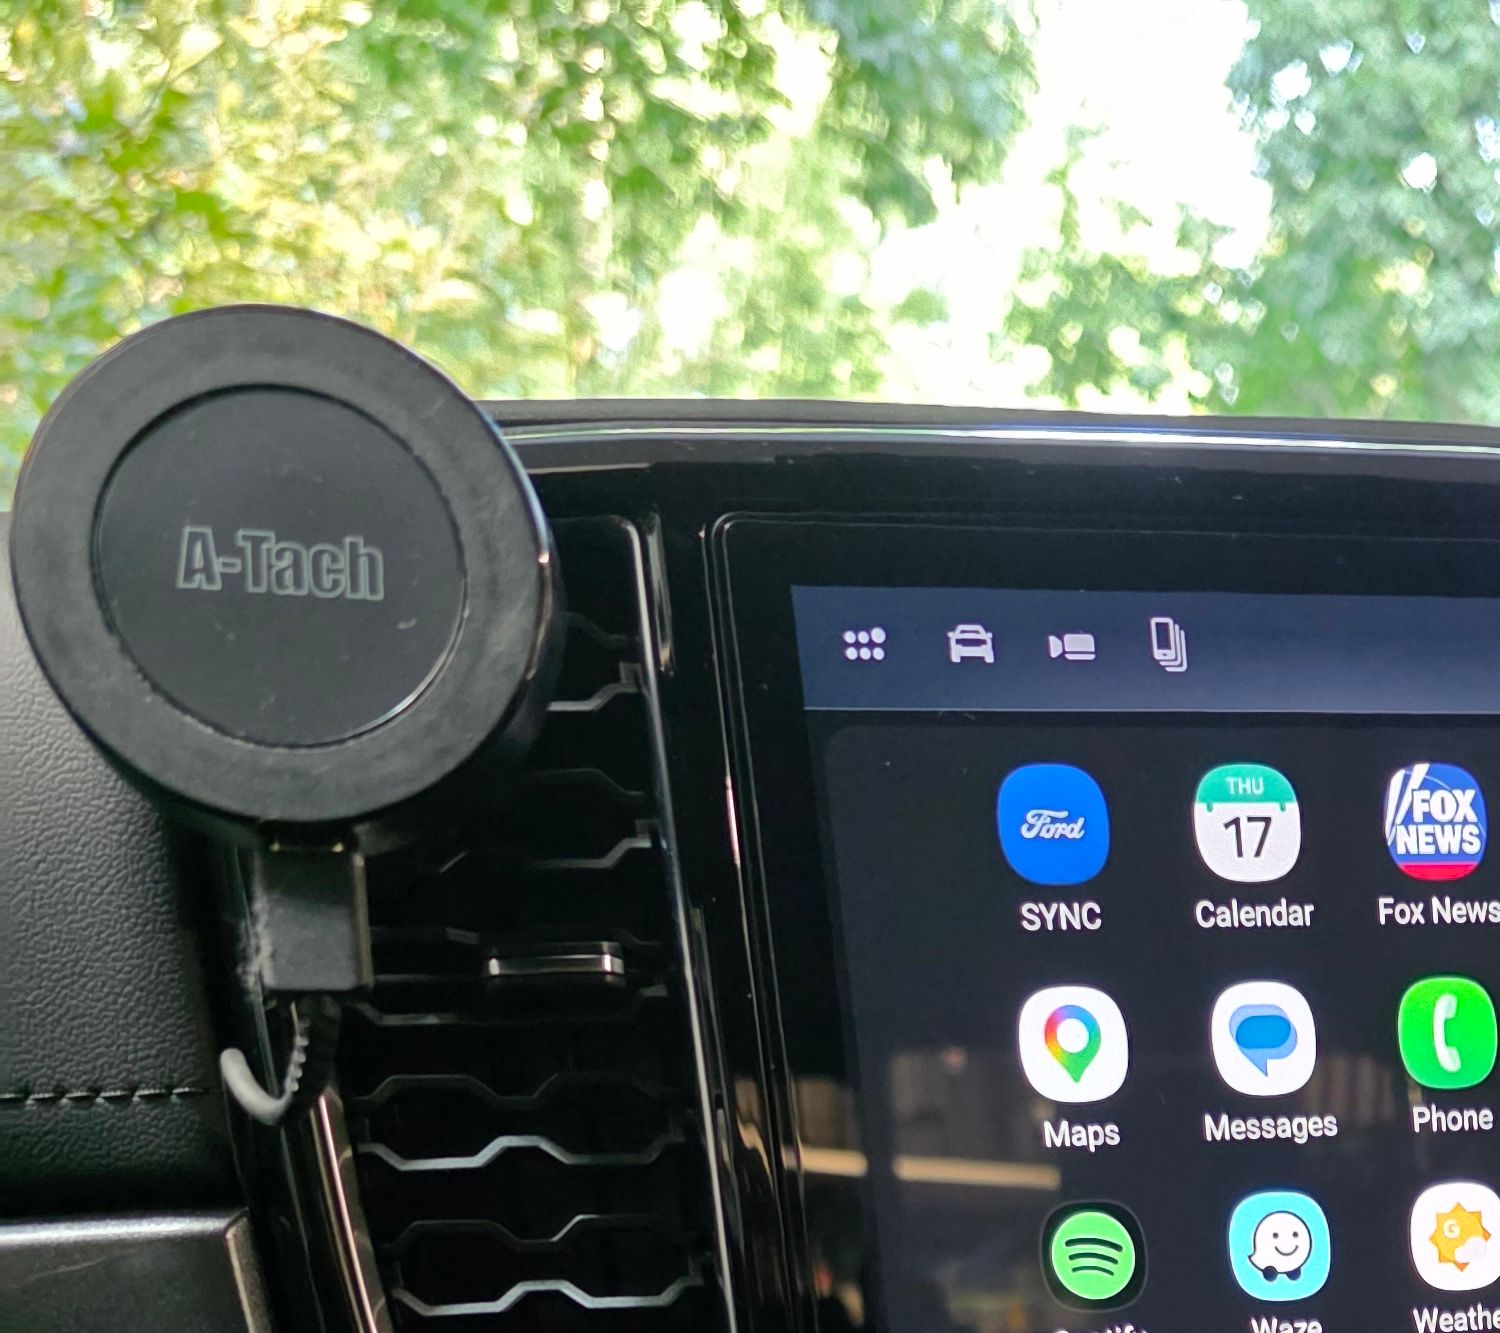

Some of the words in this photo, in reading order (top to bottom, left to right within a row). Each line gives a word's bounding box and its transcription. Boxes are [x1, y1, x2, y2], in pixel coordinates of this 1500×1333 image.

[176, 525, 385, 600] A-Tach
[1226, 777, 1265, 795] THU
[1411, 789, 1477, 824] FOX
[1020, 809, 1086, 840] Ford
[1223, 816, 1273, 859] 17
[1395, 824, 1481, 855] NEWS
[1020, 901, 1102, 932] SYNC
[1195, 897, 1315, 929] Calendar
[1378, 896, 1424, 925] Fox
[1203, 1111, 1339, 1145] Messages
[1412, 1103, 1495, 1133] Phone
[1042, 1119, 1122, 1153] Maps
